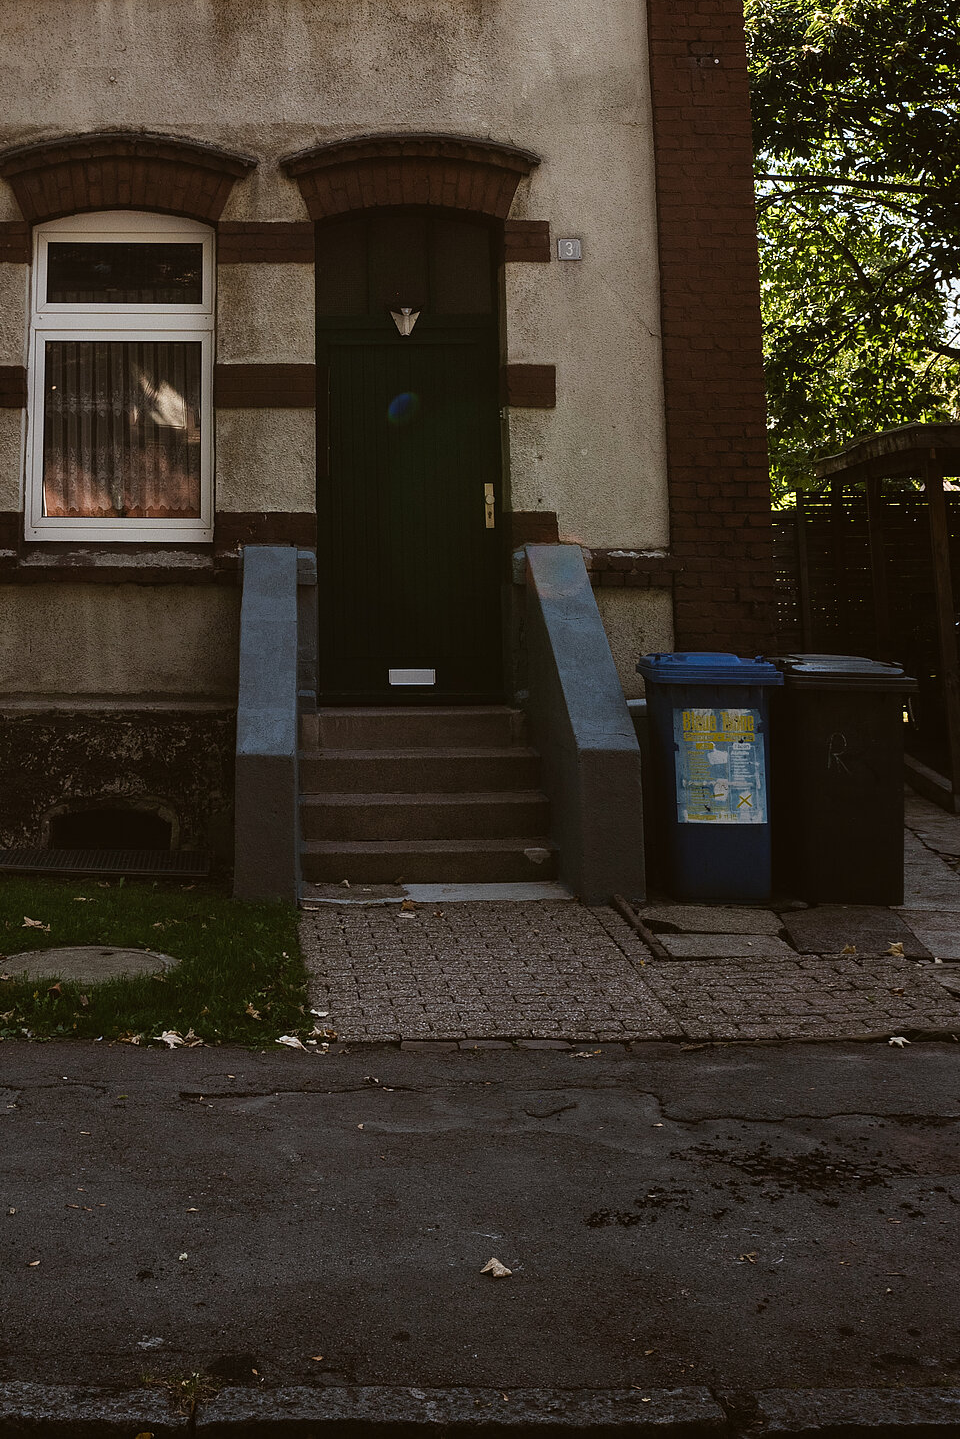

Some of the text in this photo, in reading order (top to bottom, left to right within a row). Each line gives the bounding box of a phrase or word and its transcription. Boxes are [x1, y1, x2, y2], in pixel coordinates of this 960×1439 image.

[565, 241, 573, 256] 3
[682, 712, 716, 731] Blaue
[828, 732, 850, 772] R
